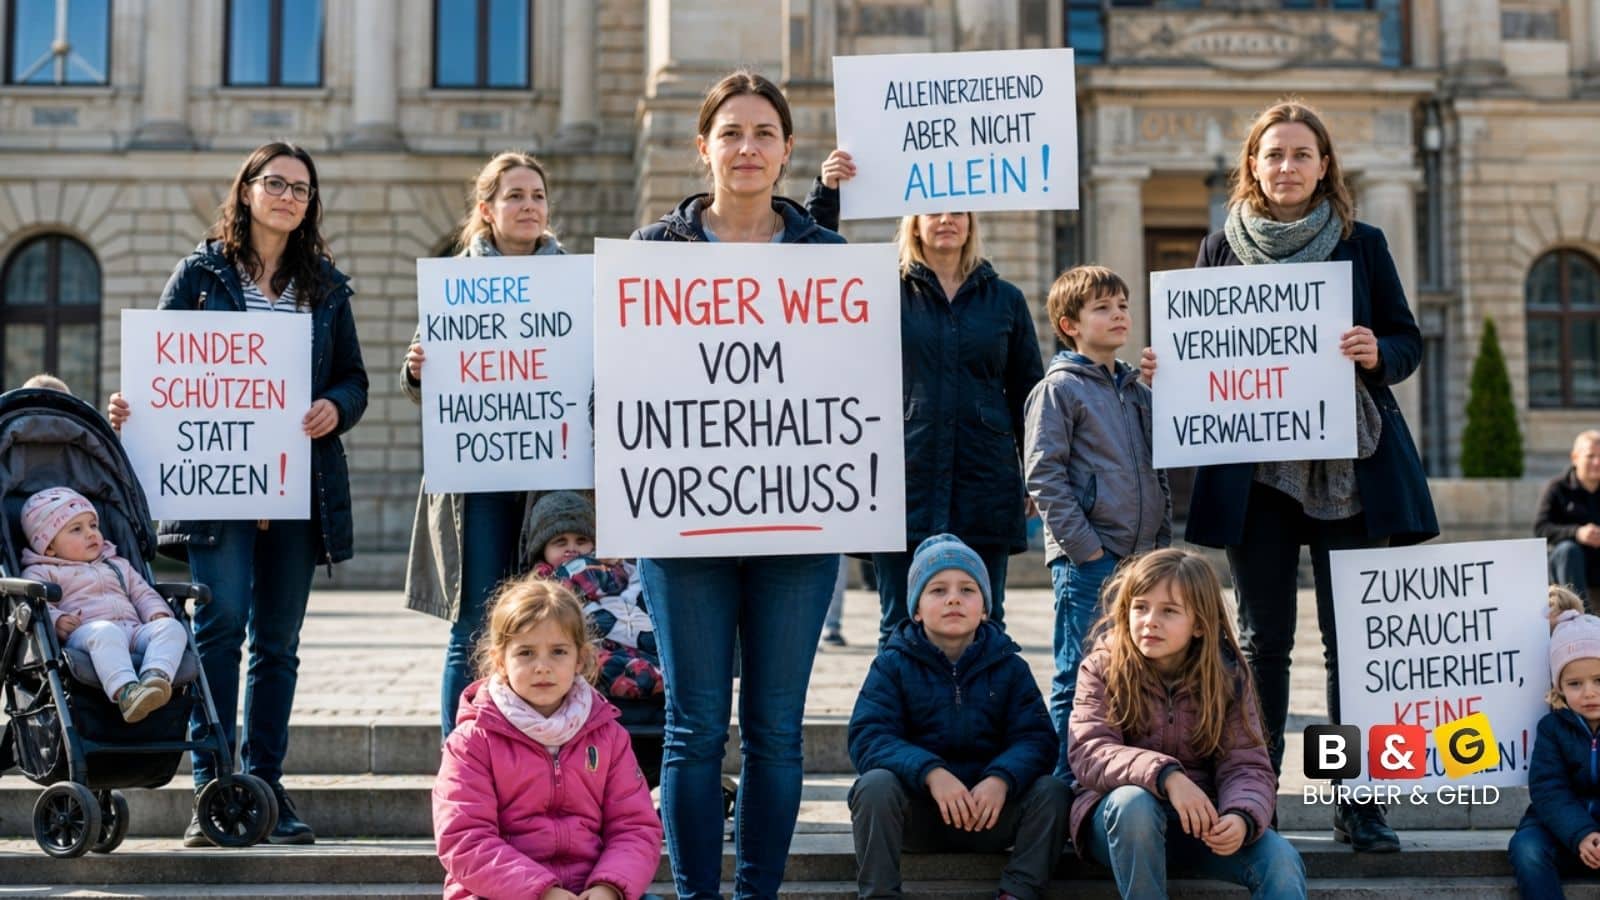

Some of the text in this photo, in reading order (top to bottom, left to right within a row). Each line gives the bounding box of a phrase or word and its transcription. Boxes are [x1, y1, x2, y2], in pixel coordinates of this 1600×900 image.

[884, 74, 1044, 111] ALLEINERZIEHEND
[903, 113, 1036, 152] ABER NICHT
[445, 276, 530, 306] UNSERE
[618, 277, 869, 328] FINGER WEG
[1167, 280, 1326, 320] KINDERARMUT
[427, 311, 573, 342] KINDER SIND
[1173, 324, 1318, 361] VERHINDERN
[157, 331, 267, 366] KINDER
[460, 348, 548, 383] KEINE
[698, 340, 785, 385] VOM
[151, 372, 285, 410] SCHÜTZEN
[1209, 364, 1290, 402] NICHT
[439, 391, 577, 424] HAUSHALTS-
[617, 396, 881, 451] UNTERHALTS-
[177, 420, 253, 452] STATT
[1360, 561, 1495, 605] ZUKUNFT
[1366, 607, 1499, 650] BRAUCHT
[1366, 649, 1524, 694] SICHERHEIT,
